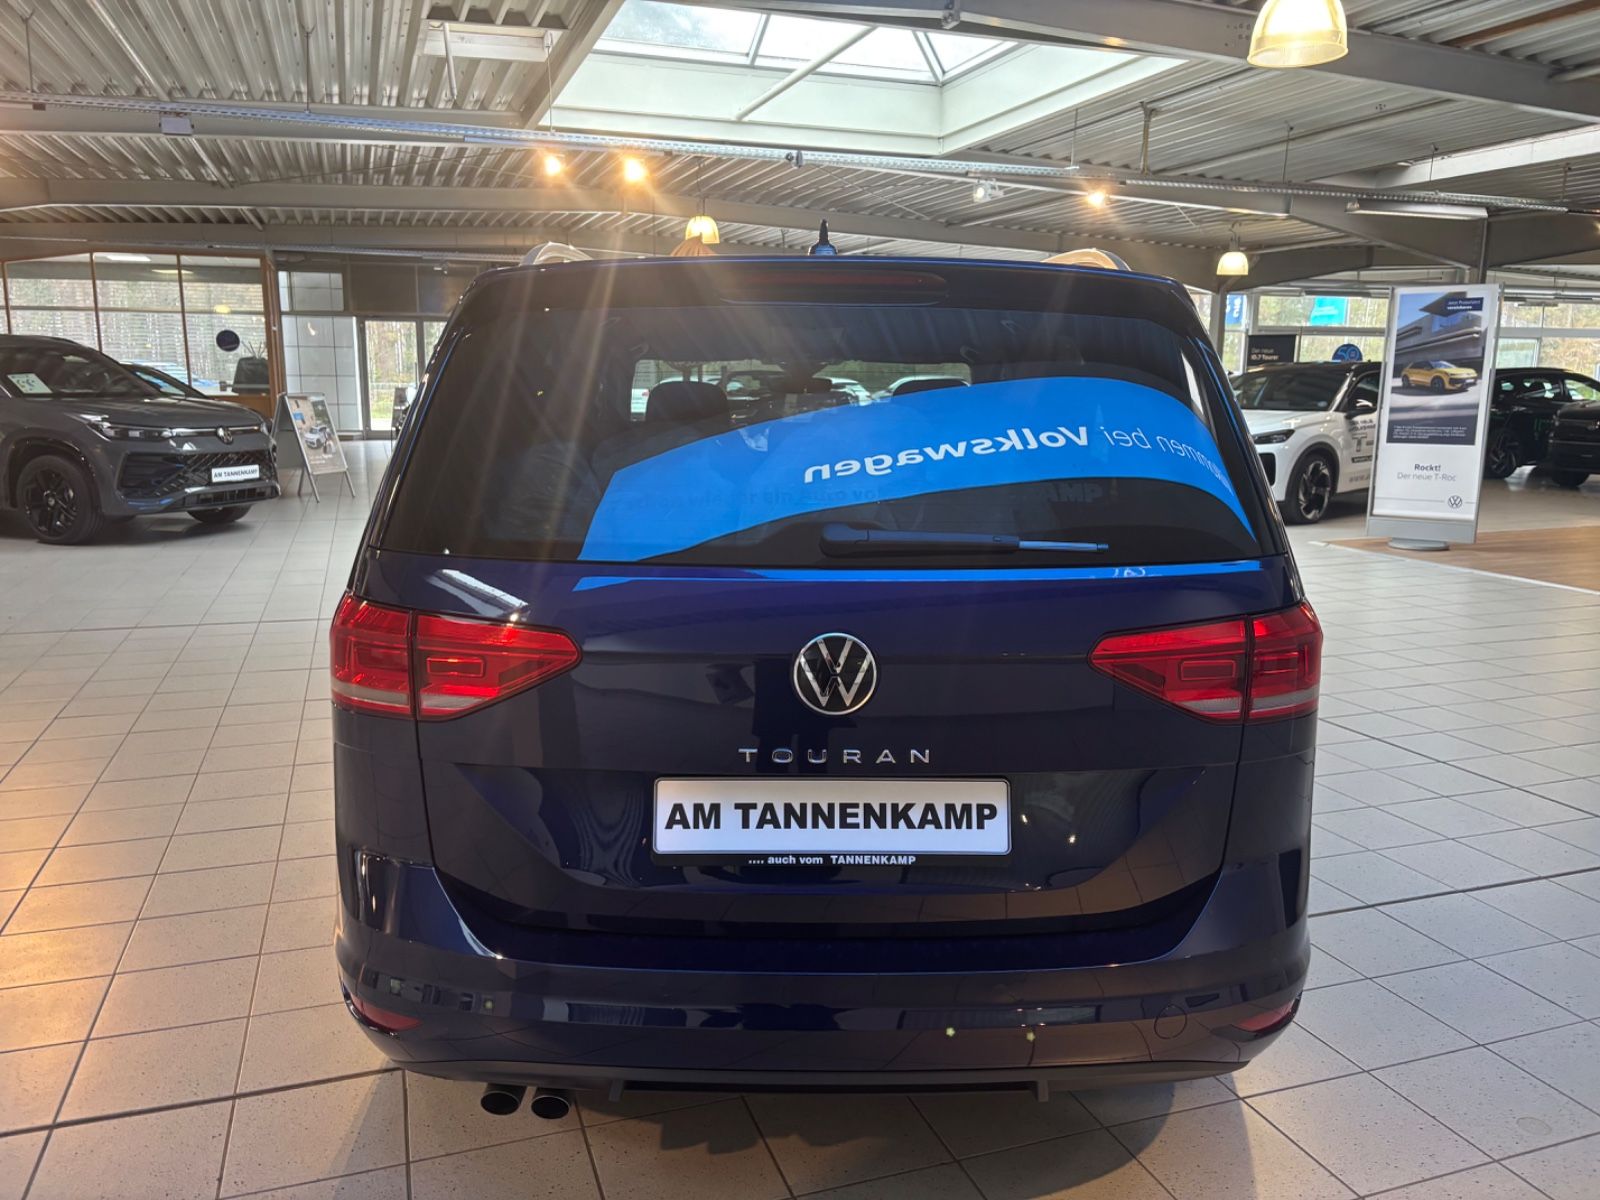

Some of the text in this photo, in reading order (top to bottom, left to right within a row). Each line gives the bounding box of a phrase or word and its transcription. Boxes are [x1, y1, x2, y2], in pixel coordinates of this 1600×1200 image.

[1414, 463, 1441, 472] Rockt!
[1397, 472, 1457, 482] Der neue T-Roc
[738, 748, 930, 764] TOURAN
[664, 802, 998, 830] AM TANNENKAMP
[767, 855, 796, 865] auch
[799, 857, 823, 865] vom
[830, 855, 917, 865] TANNENKAMP
